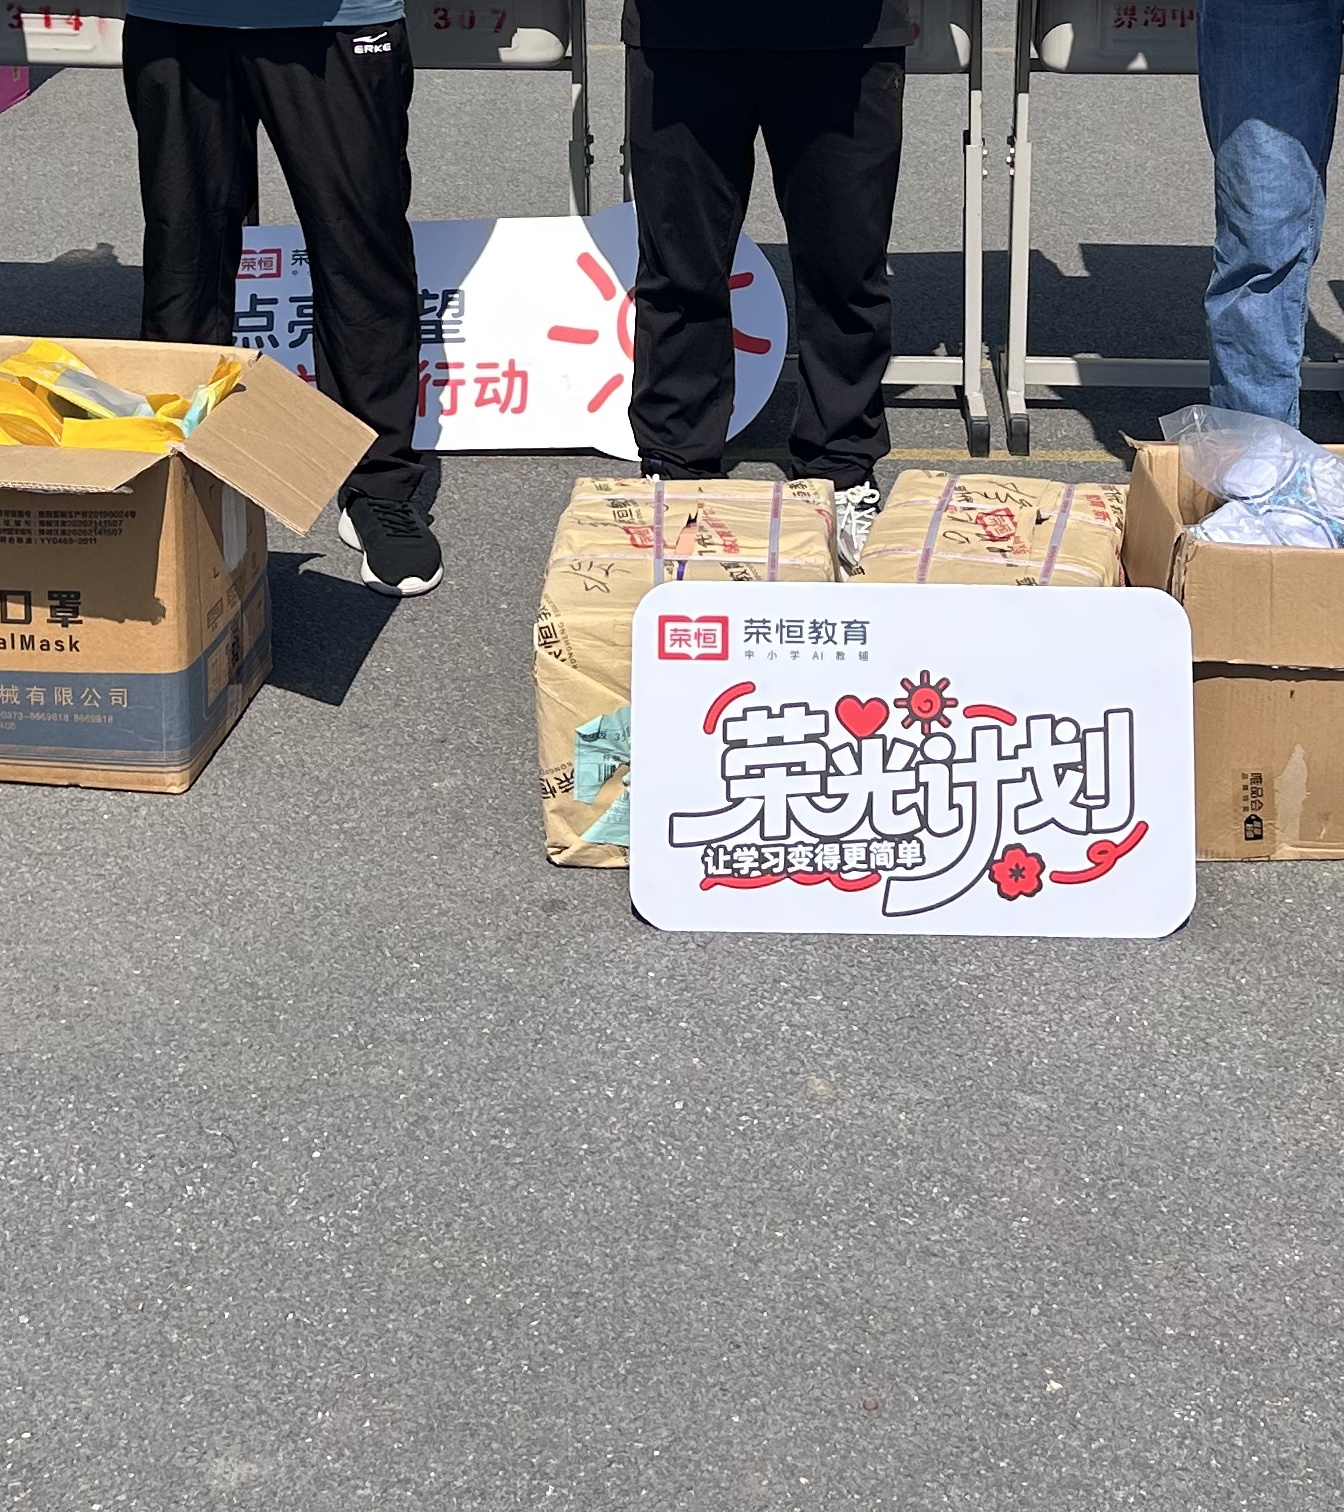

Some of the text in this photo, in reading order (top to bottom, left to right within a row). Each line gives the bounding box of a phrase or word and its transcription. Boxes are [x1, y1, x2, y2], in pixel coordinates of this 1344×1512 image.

[353, 42, 393, 55] ERKE
[240, 256, 275, 272] 荣恒
[669, 627, 718, 649] 荣恒
[743, 617, 871, 646] 荣恒教育
[669, 701, 1135, 917] 荣光计划
[702, 840, 926, 876] 让学习变得更简单
